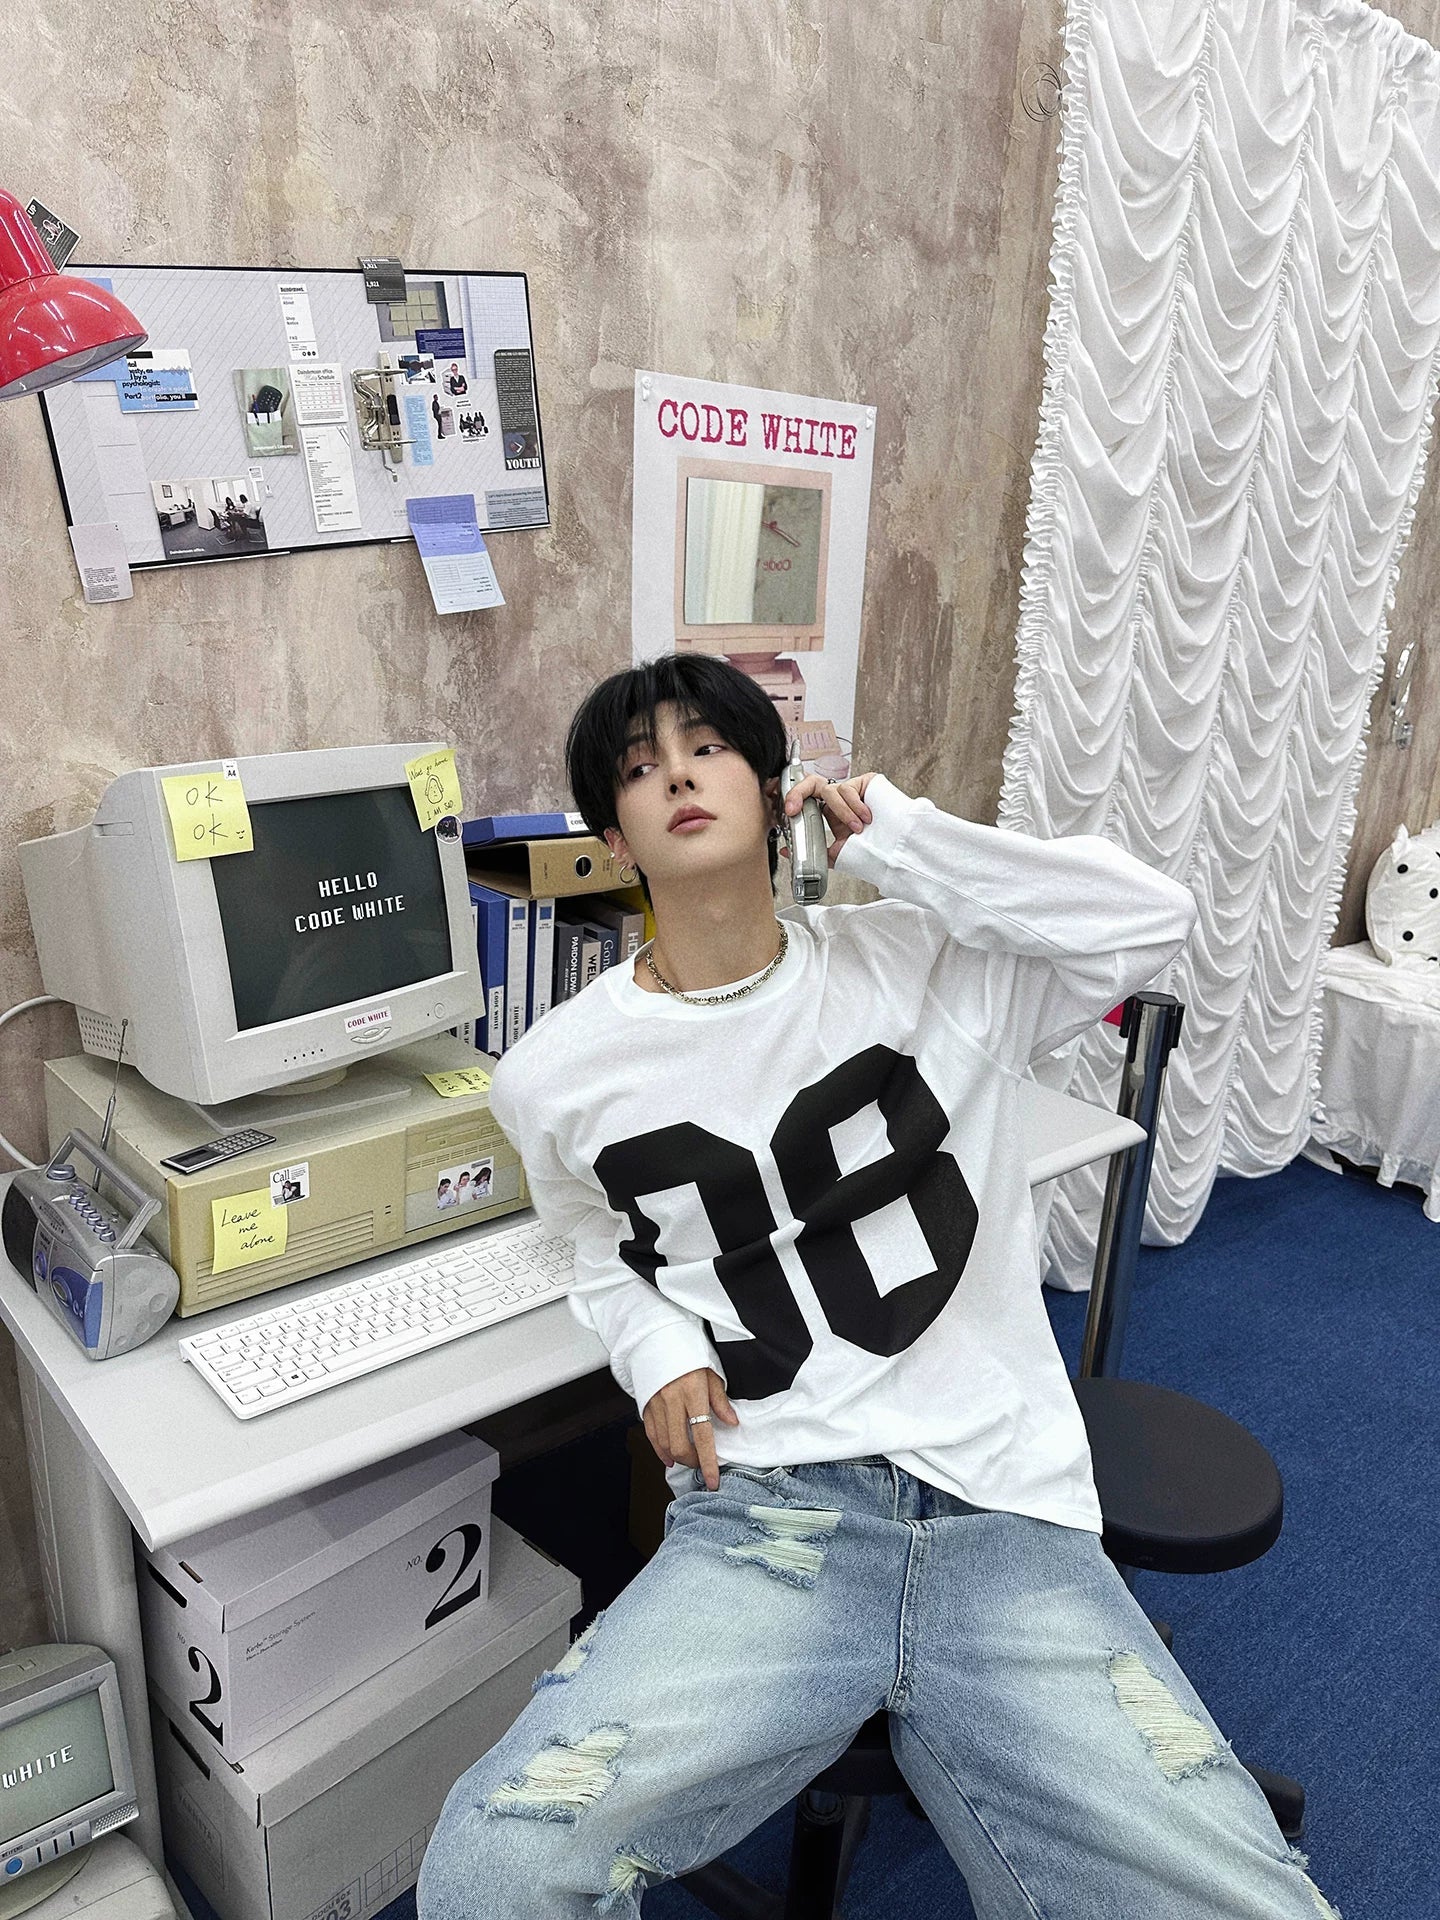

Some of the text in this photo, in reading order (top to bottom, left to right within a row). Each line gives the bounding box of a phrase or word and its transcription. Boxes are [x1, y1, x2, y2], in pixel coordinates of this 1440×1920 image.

[658, 399, 858, 460] CODE WHITE
[505, 458, 541, 470] YOUTH
[186, 781, 223, 807] OK
[194, 813, 228, 845] OK
[318, 871, 378, 898] HELLO
[294, 895, 406, 932] CODE WHITE
[570, 936, 579, 971] PARDON
[708, 985, 755, 1004] CHANEL
[347, 1011, 388, 1028] CODE WHITE
[273, 1169, 290, 1183] Call
[221, 1209, 261, 1227] Leave
[239, 1222, 258, 1234] me
[592, 1043, 980, 1402] 08
[240, 1234, 275, 1250] alone
[425, 1523, 482, 1630] 2
[188, 1646, 223, 1747] 2
[1, 1744, 75, 1789] WHITE
